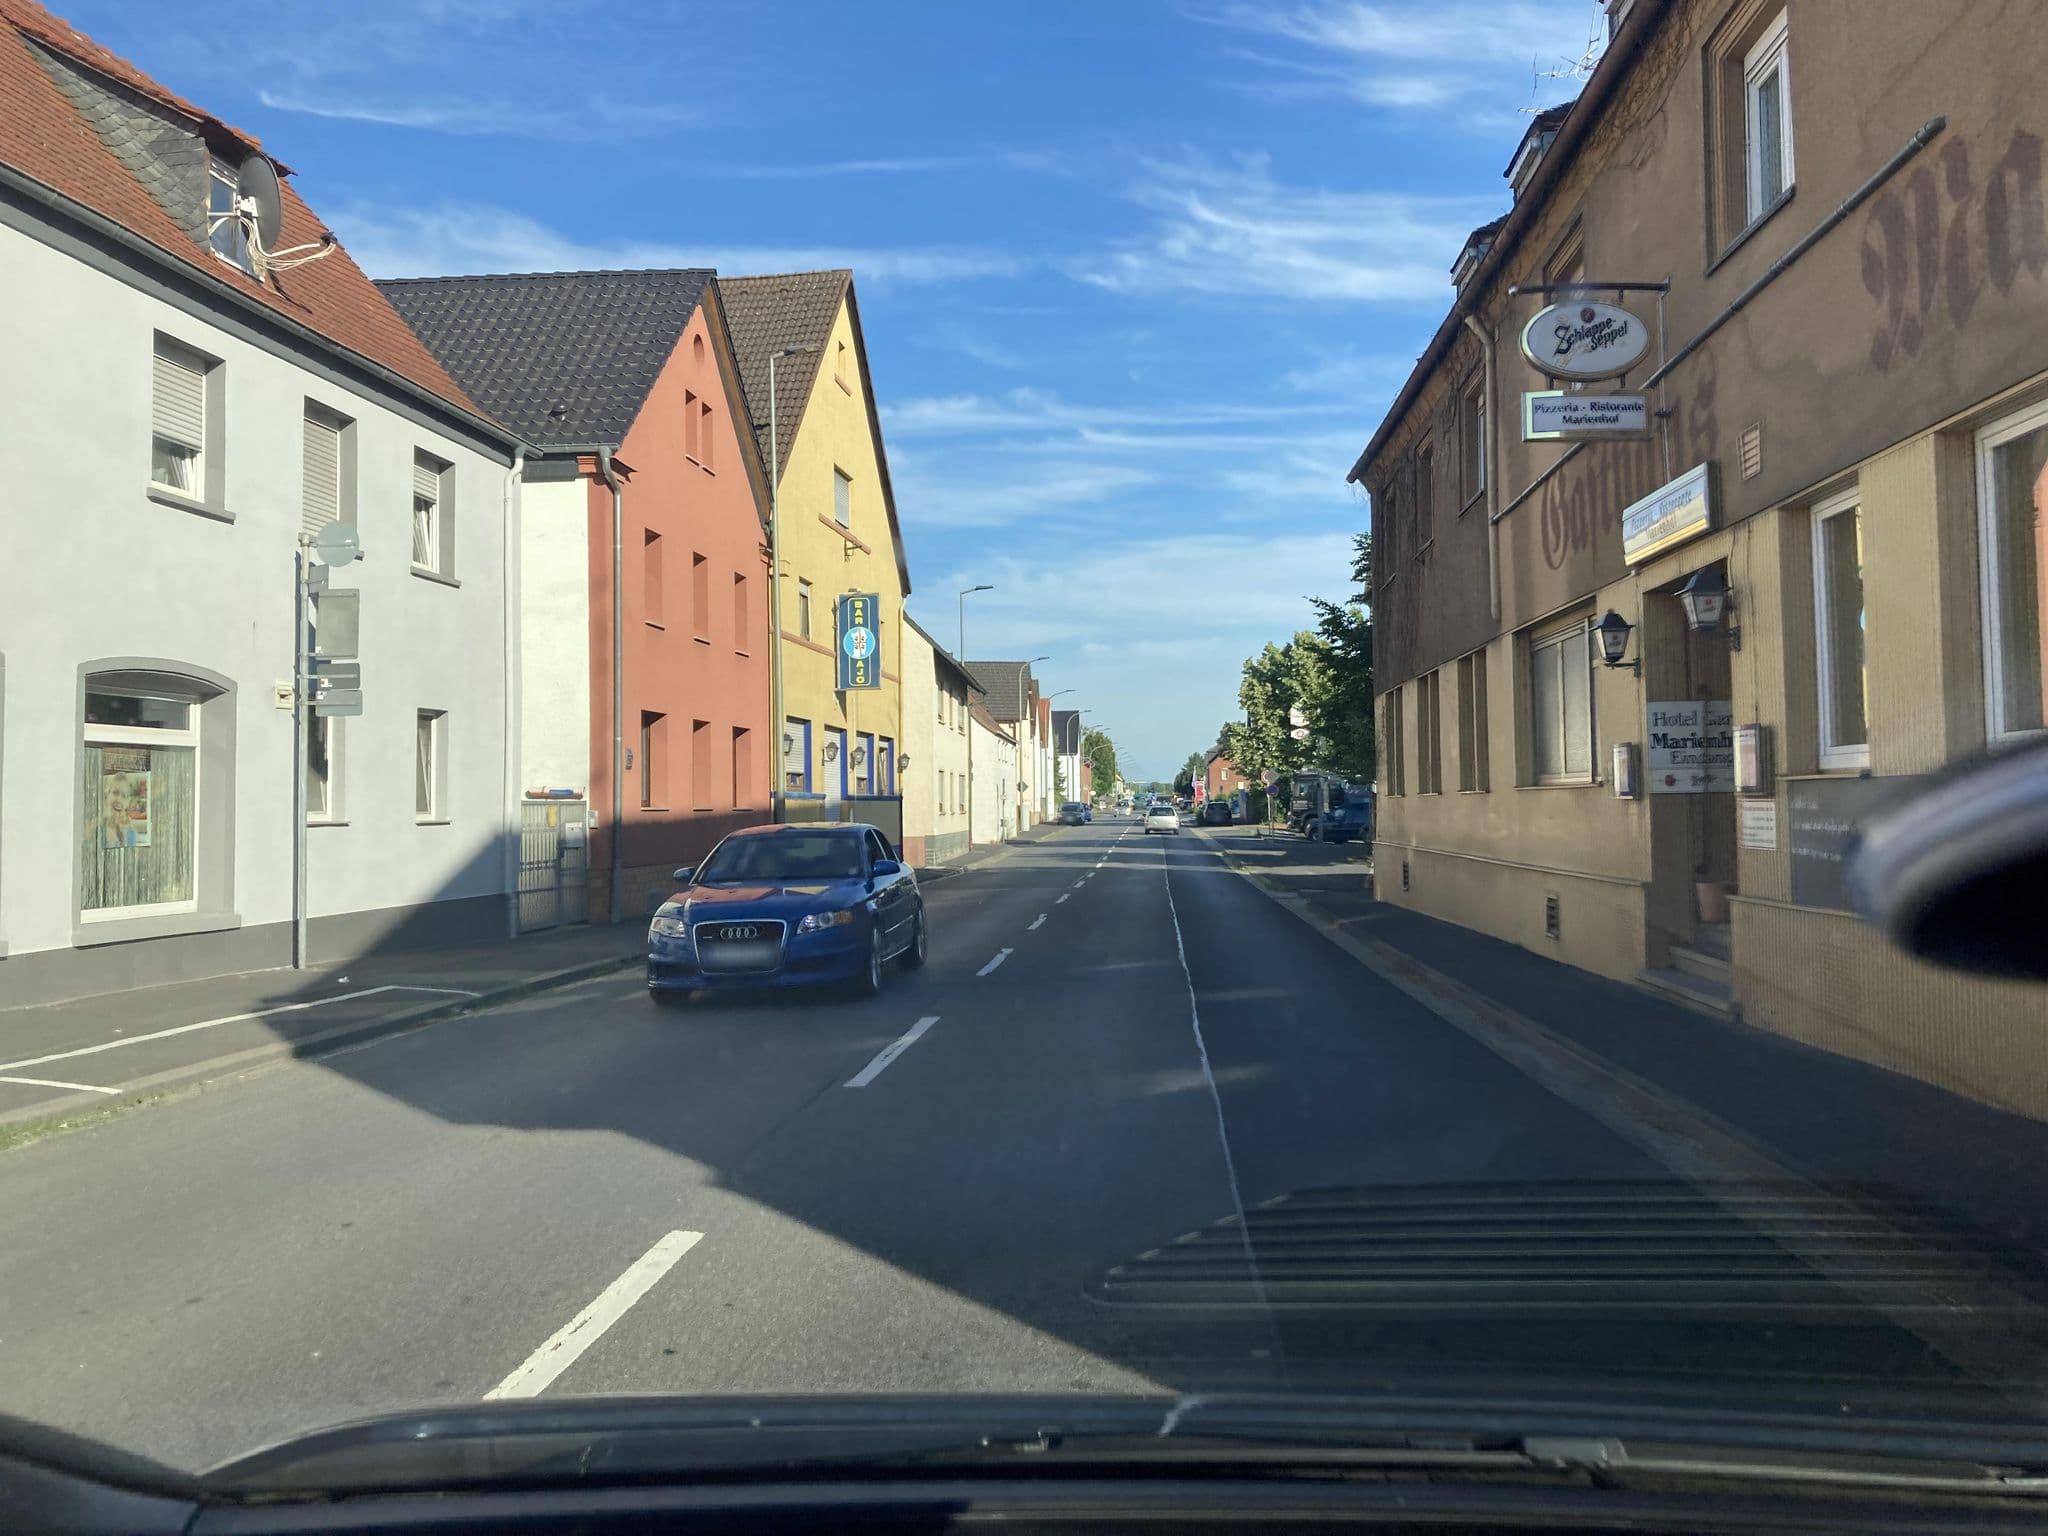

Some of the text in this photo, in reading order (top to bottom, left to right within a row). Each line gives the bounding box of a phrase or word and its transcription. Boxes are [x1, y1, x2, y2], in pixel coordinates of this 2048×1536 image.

[1590, 321, 1628, 351] Seppel
[1534, 401, 1579, 414] Pizzeria
[1590, 400, 1645, 413] Ristorante
[1562, 413, 1620, 425] Marienhof
[854, 600, 864, 625] BAR
[855, 660, 865, 684] AJO
[1652, 711, 1698, 727] Hotel
[1650, 732, 1733, 749] Marienh
